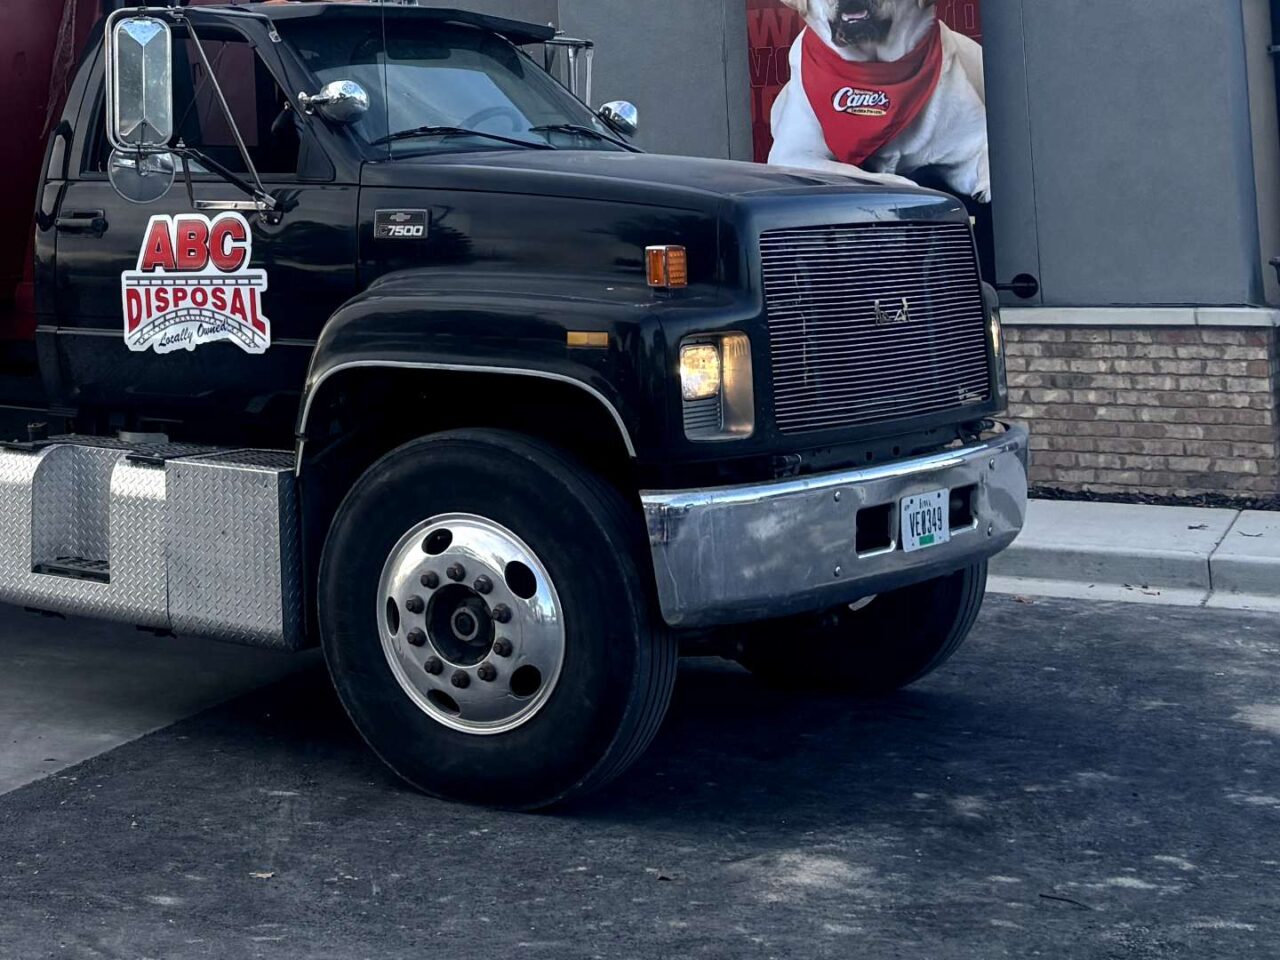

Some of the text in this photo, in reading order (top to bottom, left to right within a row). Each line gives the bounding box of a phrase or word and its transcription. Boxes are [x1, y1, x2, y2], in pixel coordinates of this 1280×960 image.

[833, 87, 888, 111] Cane's
[142, 217, 247, 272] ABC
[126, 287, 266, 336] DISPOSAL
[159, 327, 193, 346] Locally
